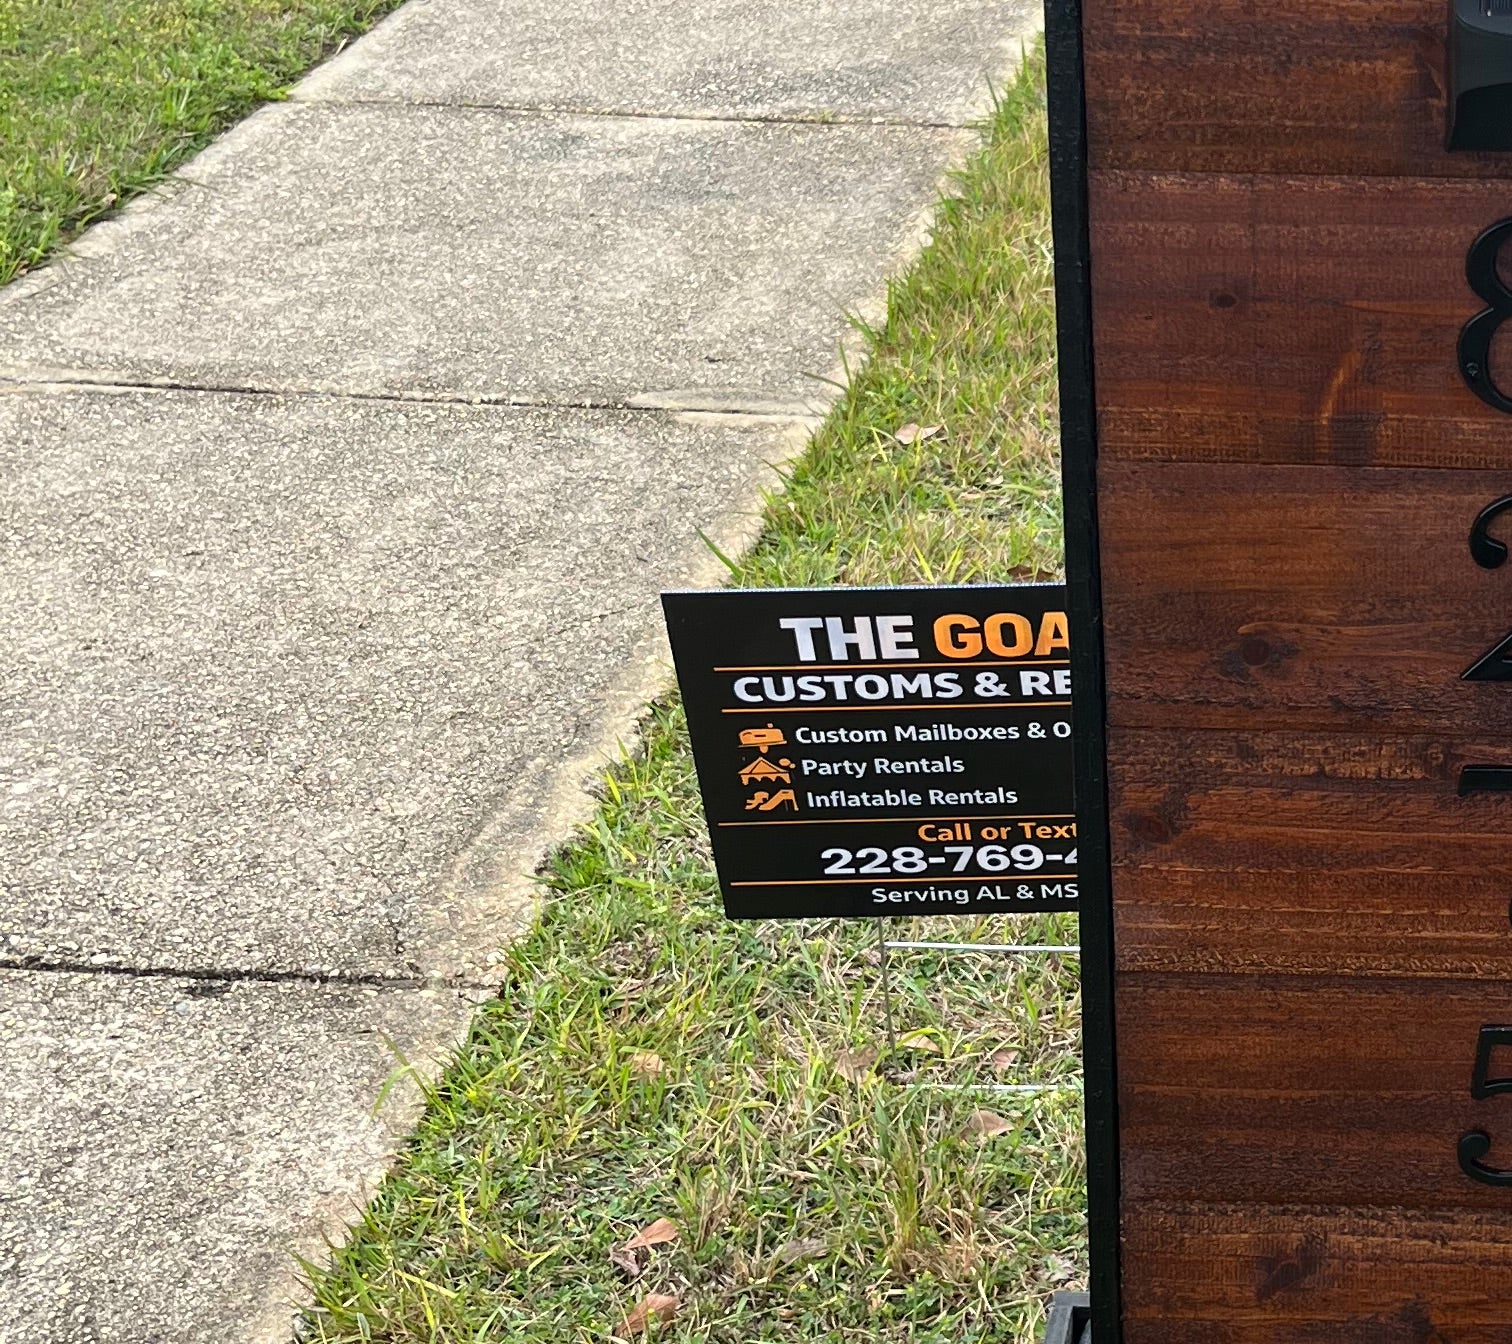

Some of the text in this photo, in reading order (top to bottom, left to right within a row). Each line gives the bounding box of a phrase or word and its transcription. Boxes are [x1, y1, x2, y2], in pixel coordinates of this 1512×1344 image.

[779, 611, 1070, 661] THE GOA
[734, 669, 1072, 702] CUSTOMS & RE
[795, 727, 888, 744] Custom
[894, 723, 1020, 742] Mailboxes
[1027, 721, 1047, 739] &
[801, 755, 965, 779] Party Rentals
[806, 786, 1018, 808] Inflatable Rentals
[917, 821, 1077, 842] Call or Text
[871, 883, 1079, 905] Serving AL & MS
